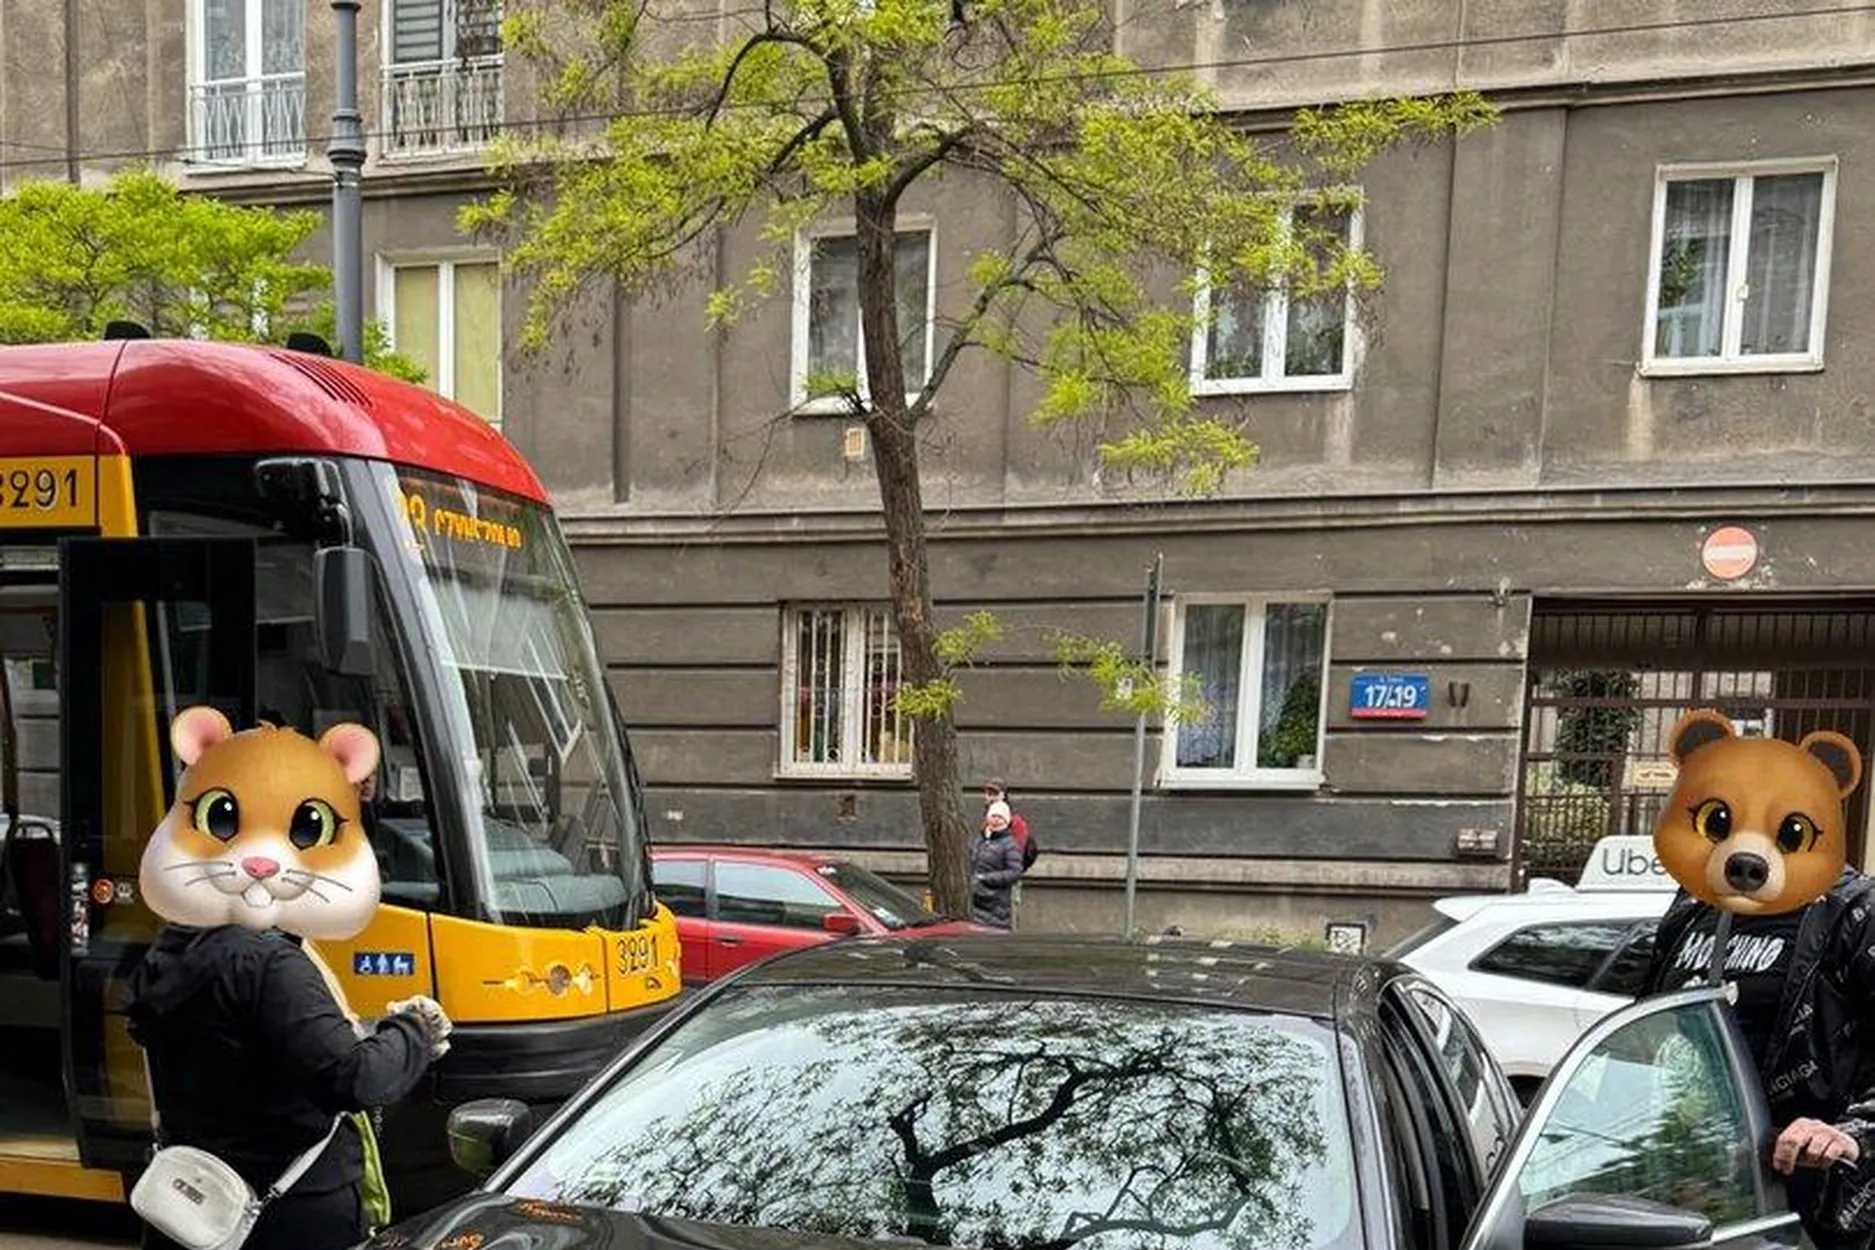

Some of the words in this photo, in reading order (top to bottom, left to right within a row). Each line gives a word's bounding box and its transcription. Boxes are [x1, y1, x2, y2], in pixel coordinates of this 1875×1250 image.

[0, 469, 77, 508] 291
[1364, 684, 1418, 709] 17/19
[1602, 848, 1668, 876] Ube
[615, 935, 659, 975] 3291
